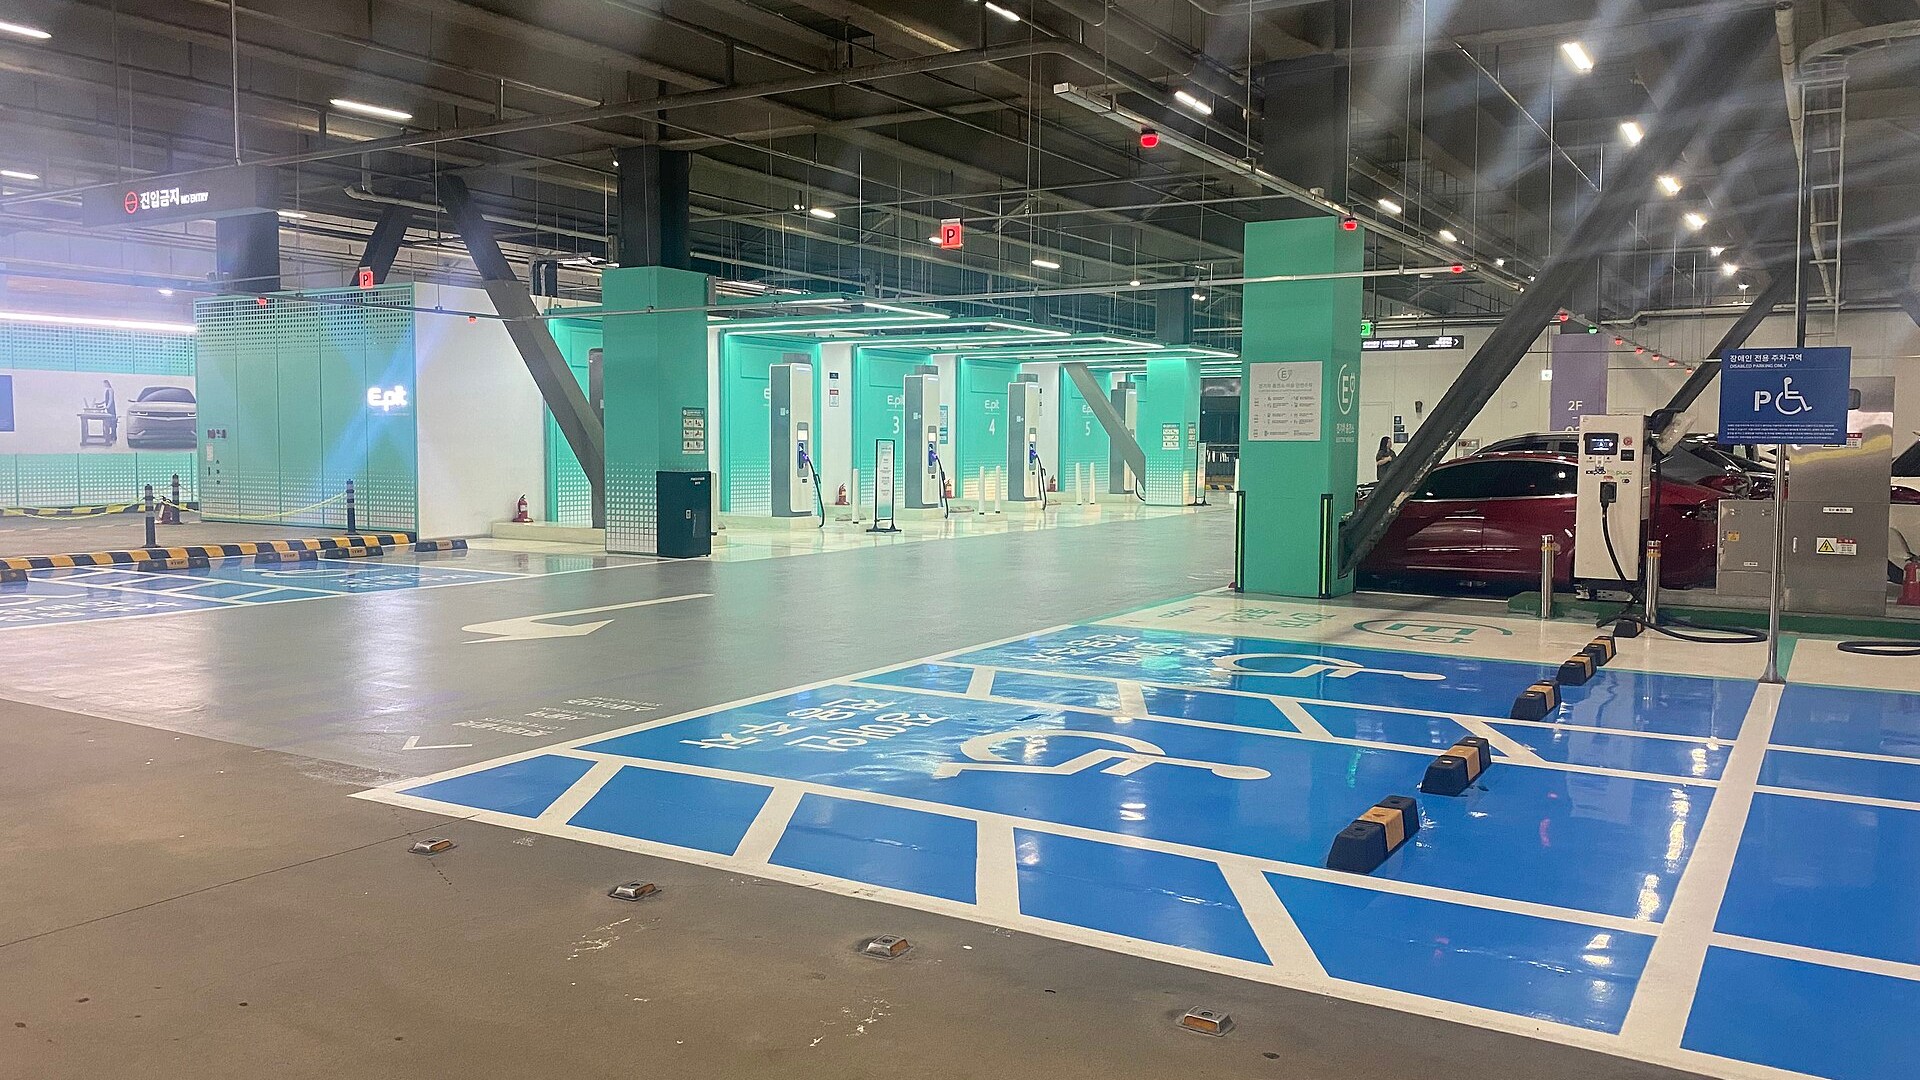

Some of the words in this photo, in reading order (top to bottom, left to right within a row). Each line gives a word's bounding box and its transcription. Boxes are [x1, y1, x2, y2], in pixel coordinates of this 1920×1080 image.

[140, 187, 180, 210] 진입금지
[947, 228, 956, 244] P
[1729, 354, 1753, 363] 장애인
[1754, 354, 1770, 363] 전용
[1771, 353, 1803, 362] 주차구역
[1568, 400, 1583, 411] 2F
[1754, 390, 1772, 411] P
[892, 416, 900, 434] 3
[988, 418, 996, 436] 4
[1085, 421, 1091, 436] 5
[786, 698, 898, 721] 전용
[679, 721, 808, 750] 주차
[784, 712, 950, 752] 장애인
